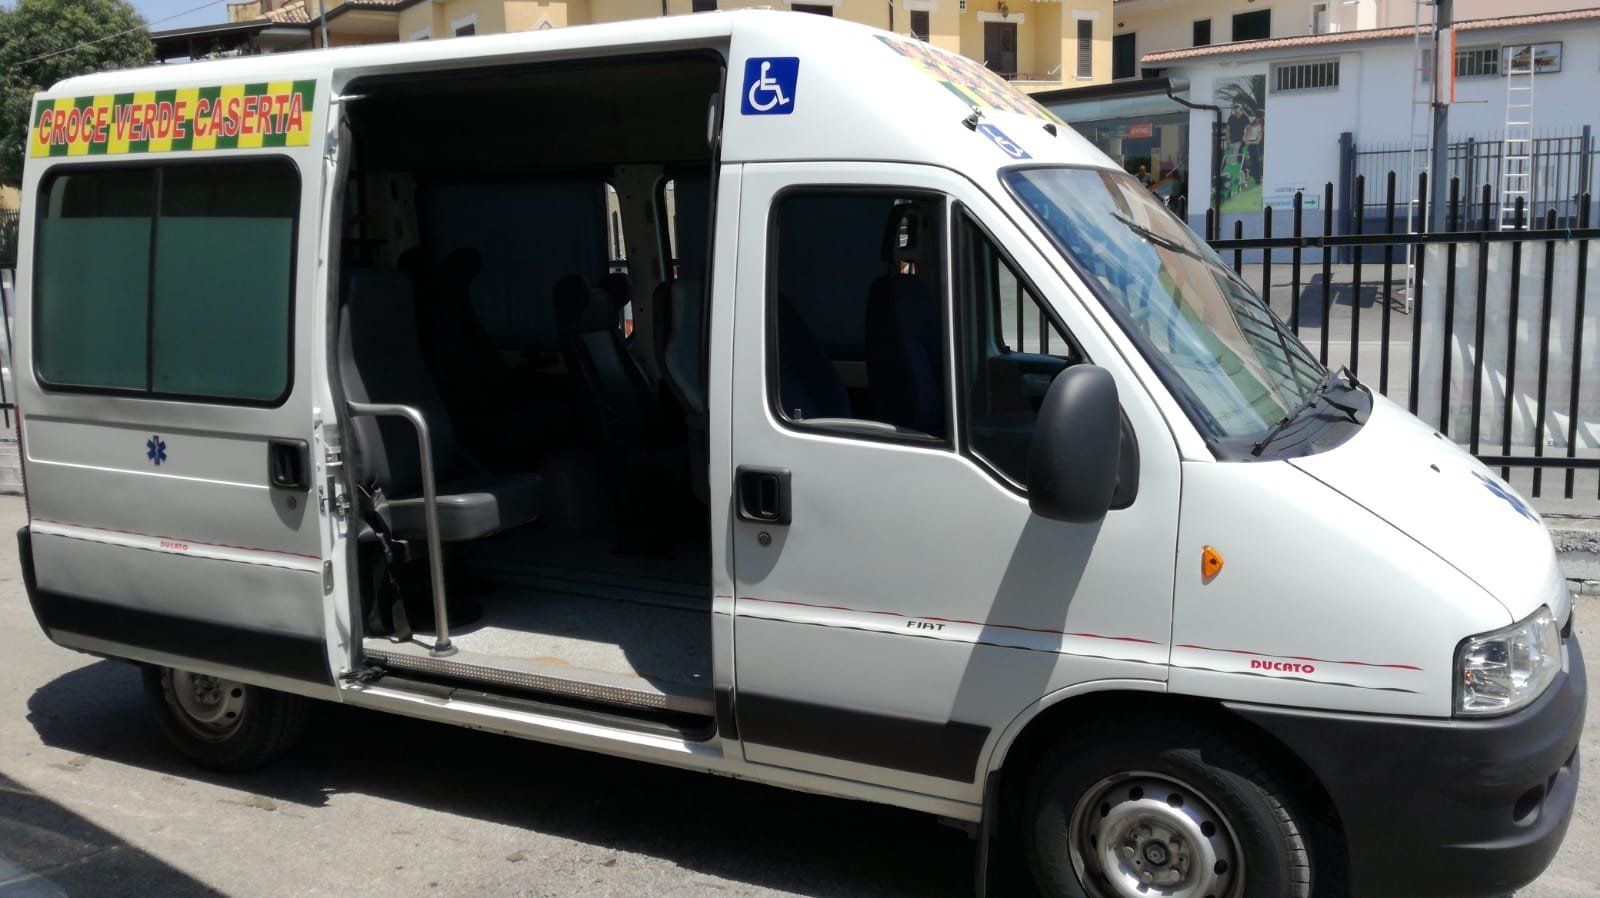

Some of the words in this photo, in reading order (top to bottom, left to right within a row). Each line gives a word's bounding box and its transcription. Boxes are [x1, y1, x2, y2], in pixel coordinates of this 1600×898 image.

[38, 107, 109, 145] CROCE
[115, 101, 187, 141] VERDE
[193, 93, 304, 138] CASERTA
[160, 541, 189, 551] DUCATO
[906, 620, 947, 631] FIAT
[1250, 659, 1315, 674] DUCATO
